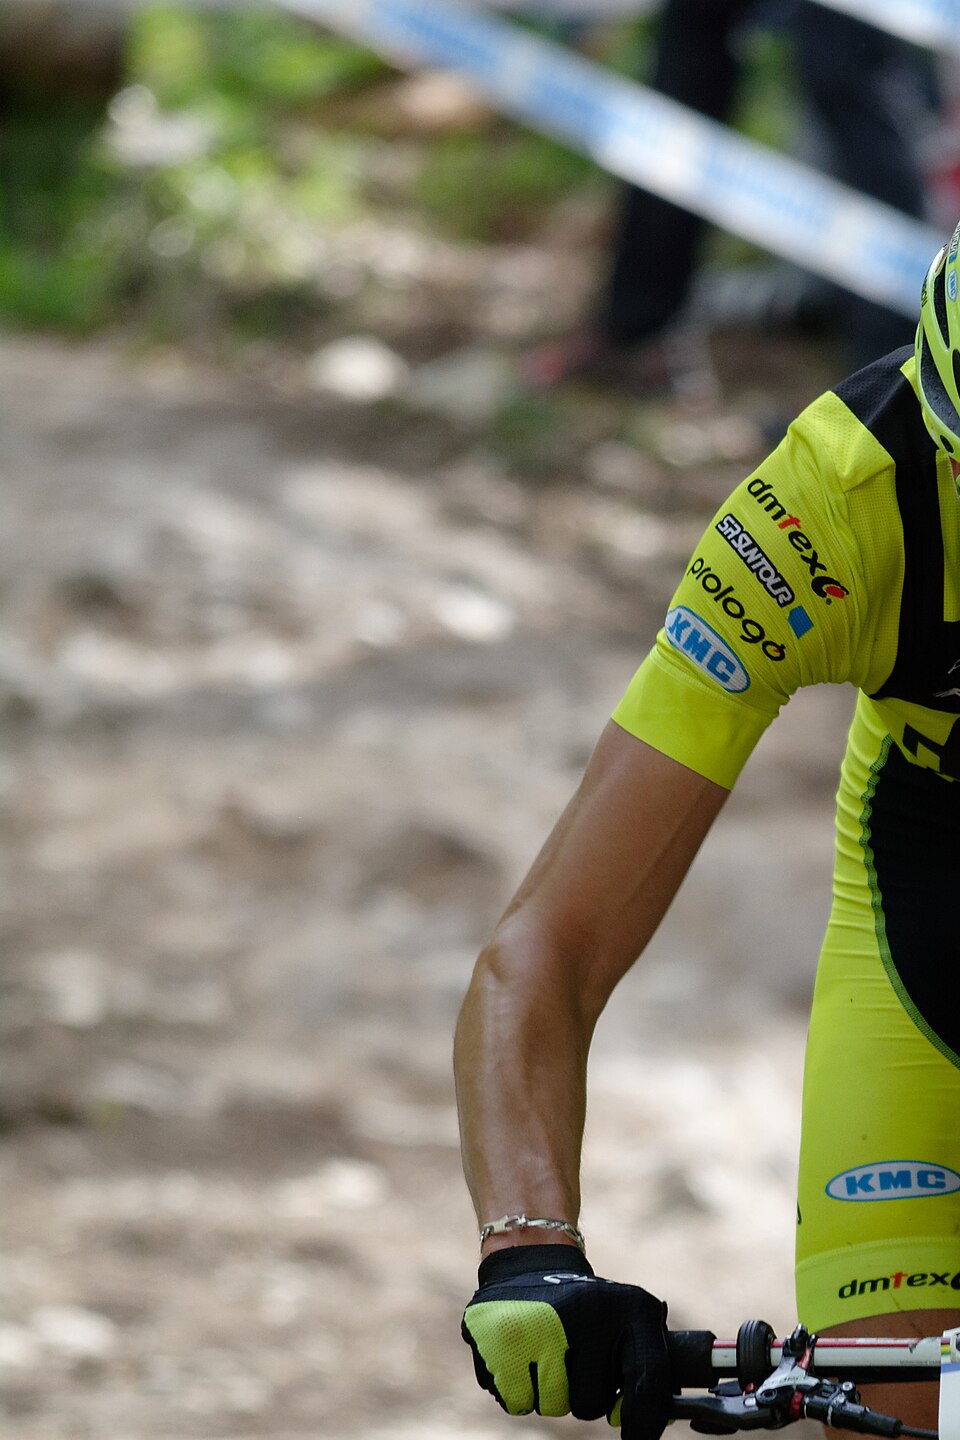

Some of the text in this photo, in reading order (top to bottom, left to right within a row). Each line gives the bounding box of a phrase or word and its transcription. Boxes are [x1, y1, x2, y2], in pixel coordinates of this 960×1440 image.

[686, 557, 786, 662] prologo
[668, 611, 737, 684] KMC
[845, 1169, 947, 1196] KMC
